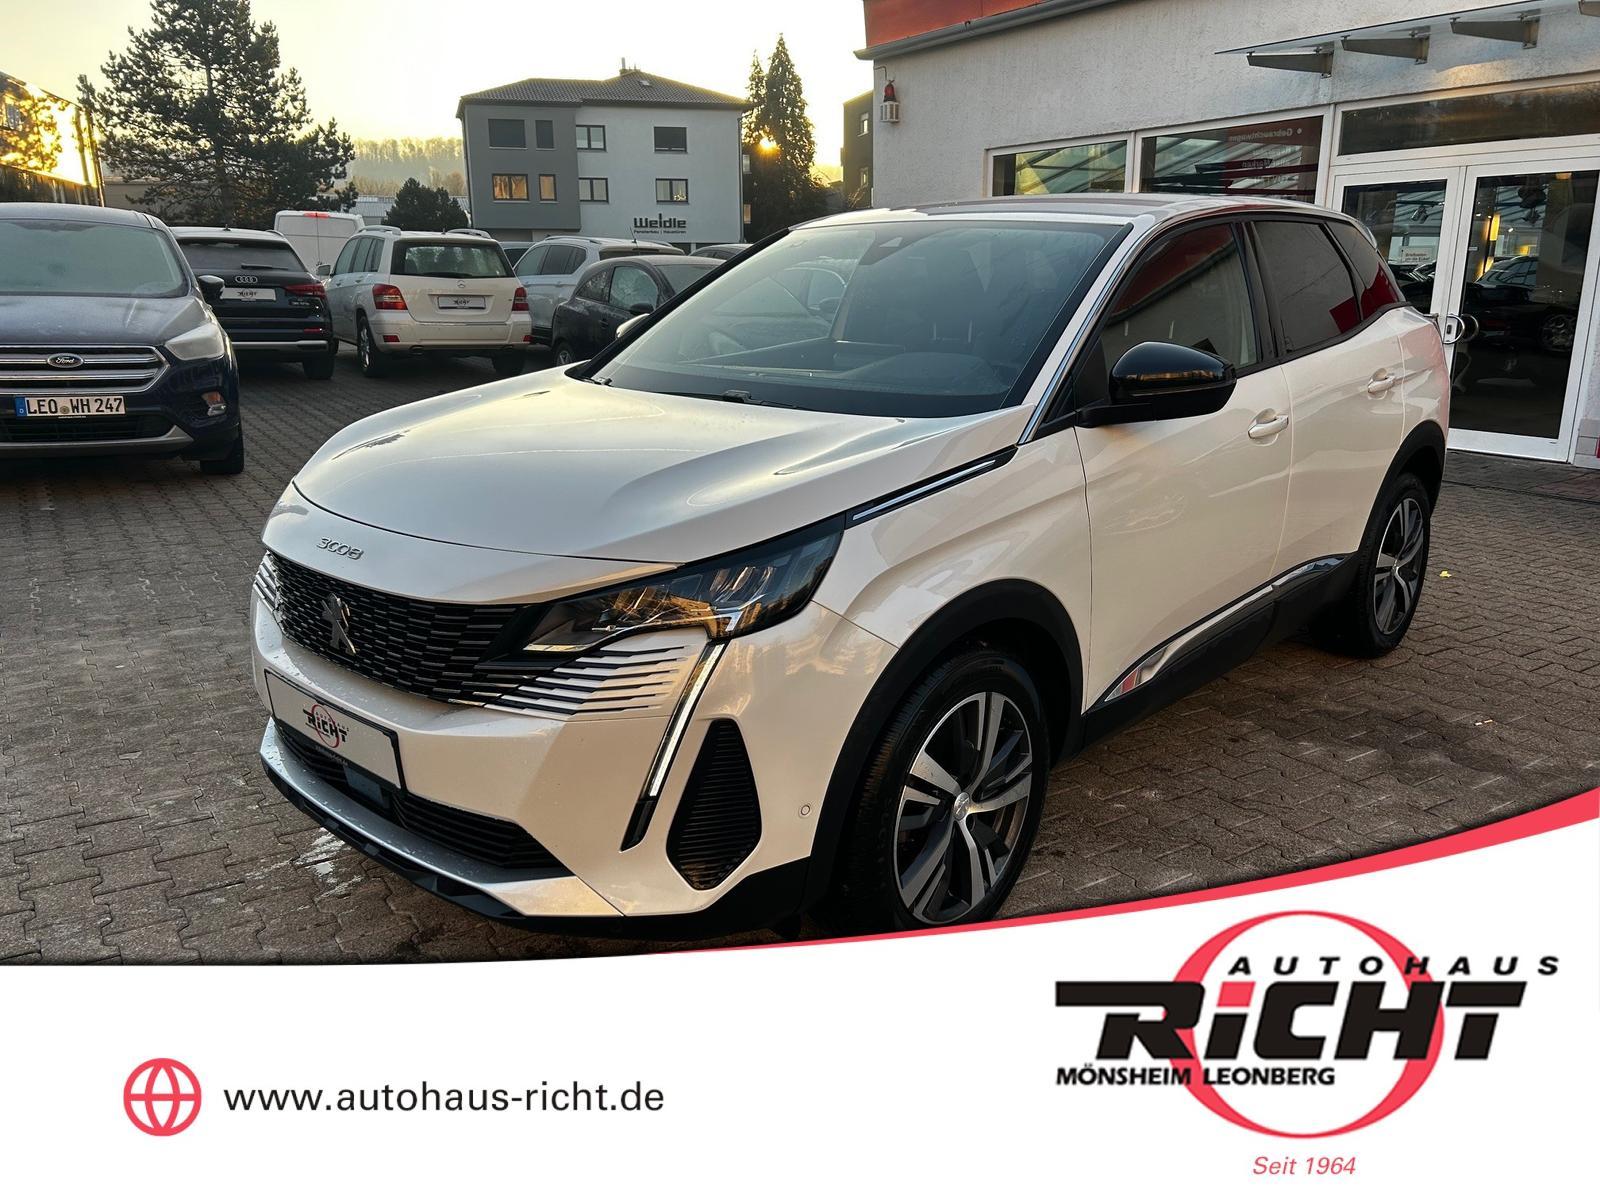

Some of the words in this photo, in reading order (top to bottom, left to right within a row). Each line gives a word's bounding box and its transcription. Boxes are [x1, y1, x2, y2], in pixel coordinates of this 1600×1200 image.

[55, 356, 75, 364] Ford
[26, 398, 58, 415] LEO
[70, 397, 91, 414] WH
[95, 397, 123, 413] 247
[316, 536, 365, 561] 3008
